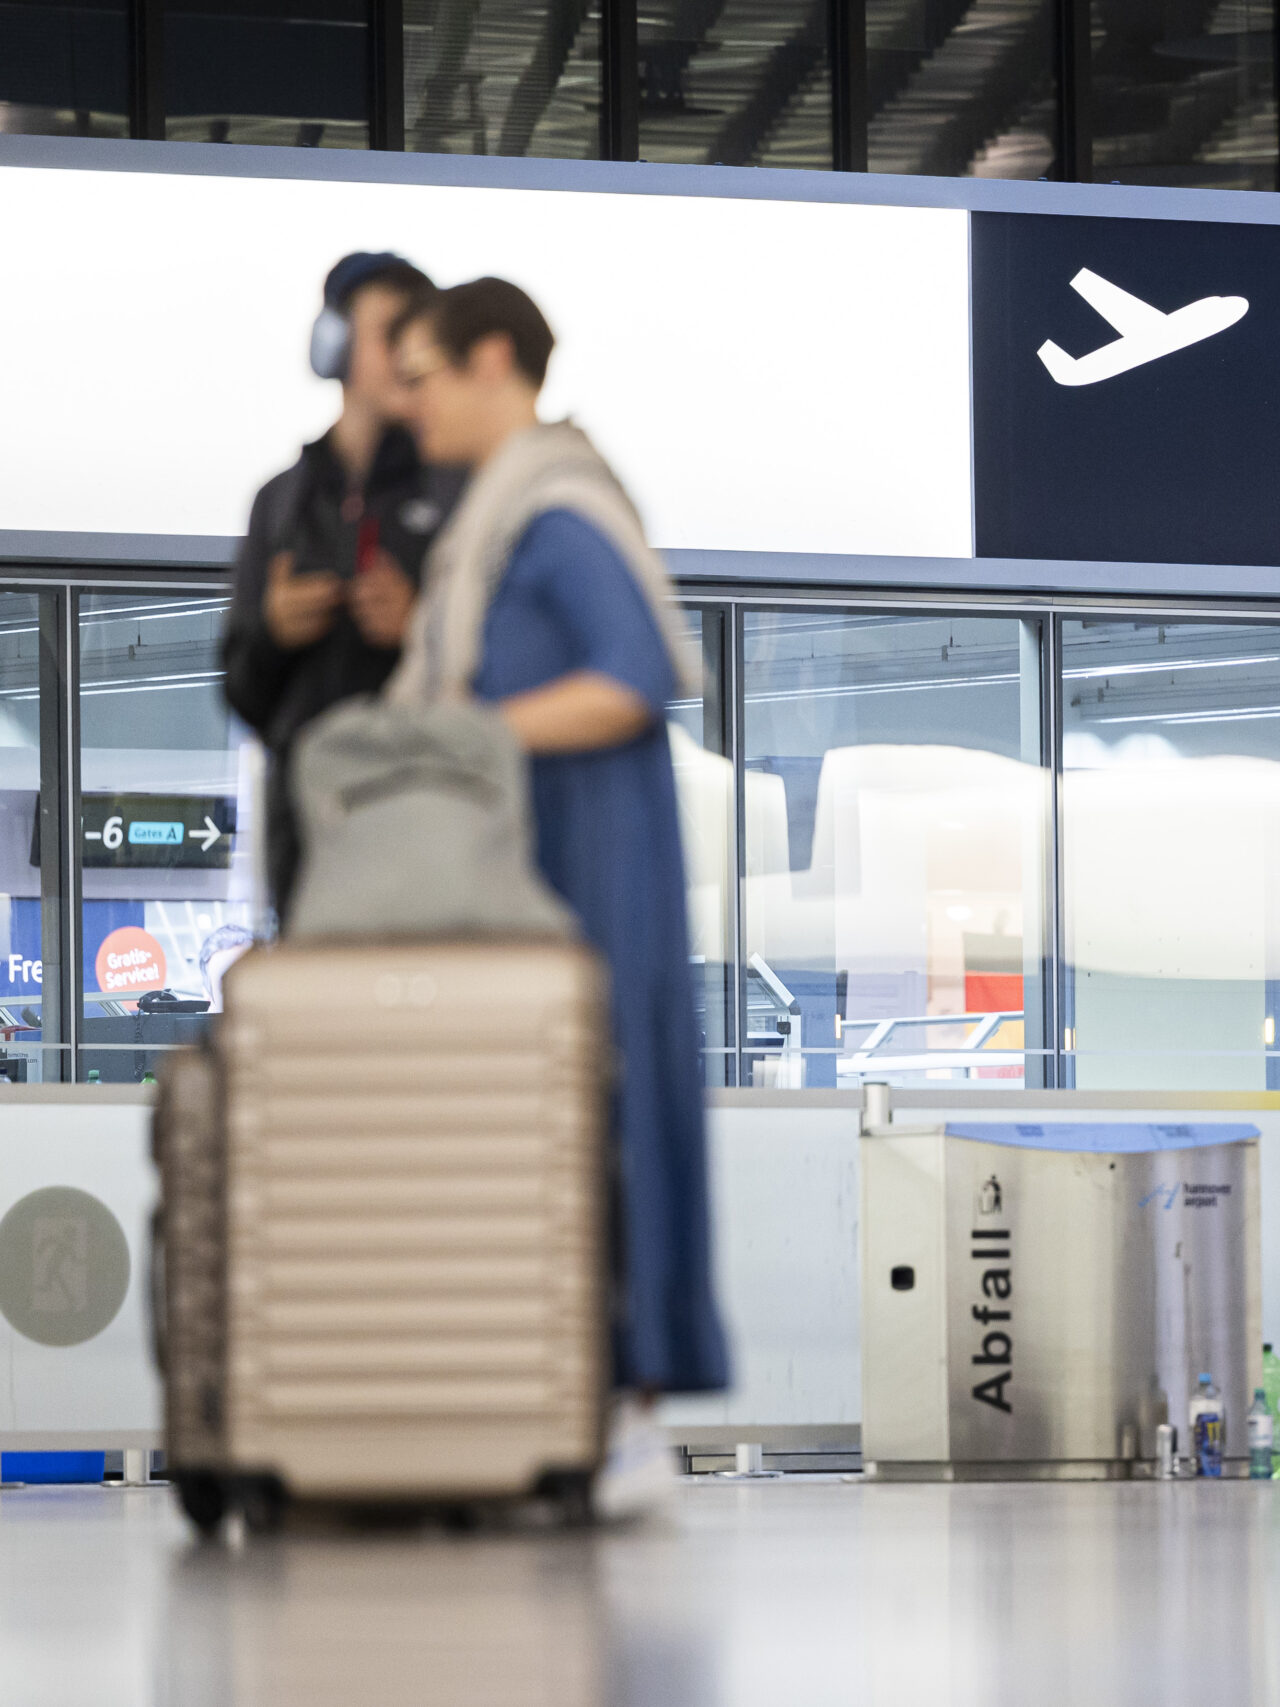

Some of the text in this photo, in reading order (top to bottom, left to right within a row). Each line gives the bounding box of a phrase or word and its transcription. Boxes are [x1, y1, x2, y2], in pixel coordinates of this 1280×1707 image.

[134, 828, 163, 839] Gates
[166, 825, 178, 842] A
[971, 1229, 1013, 1415] Abfall
